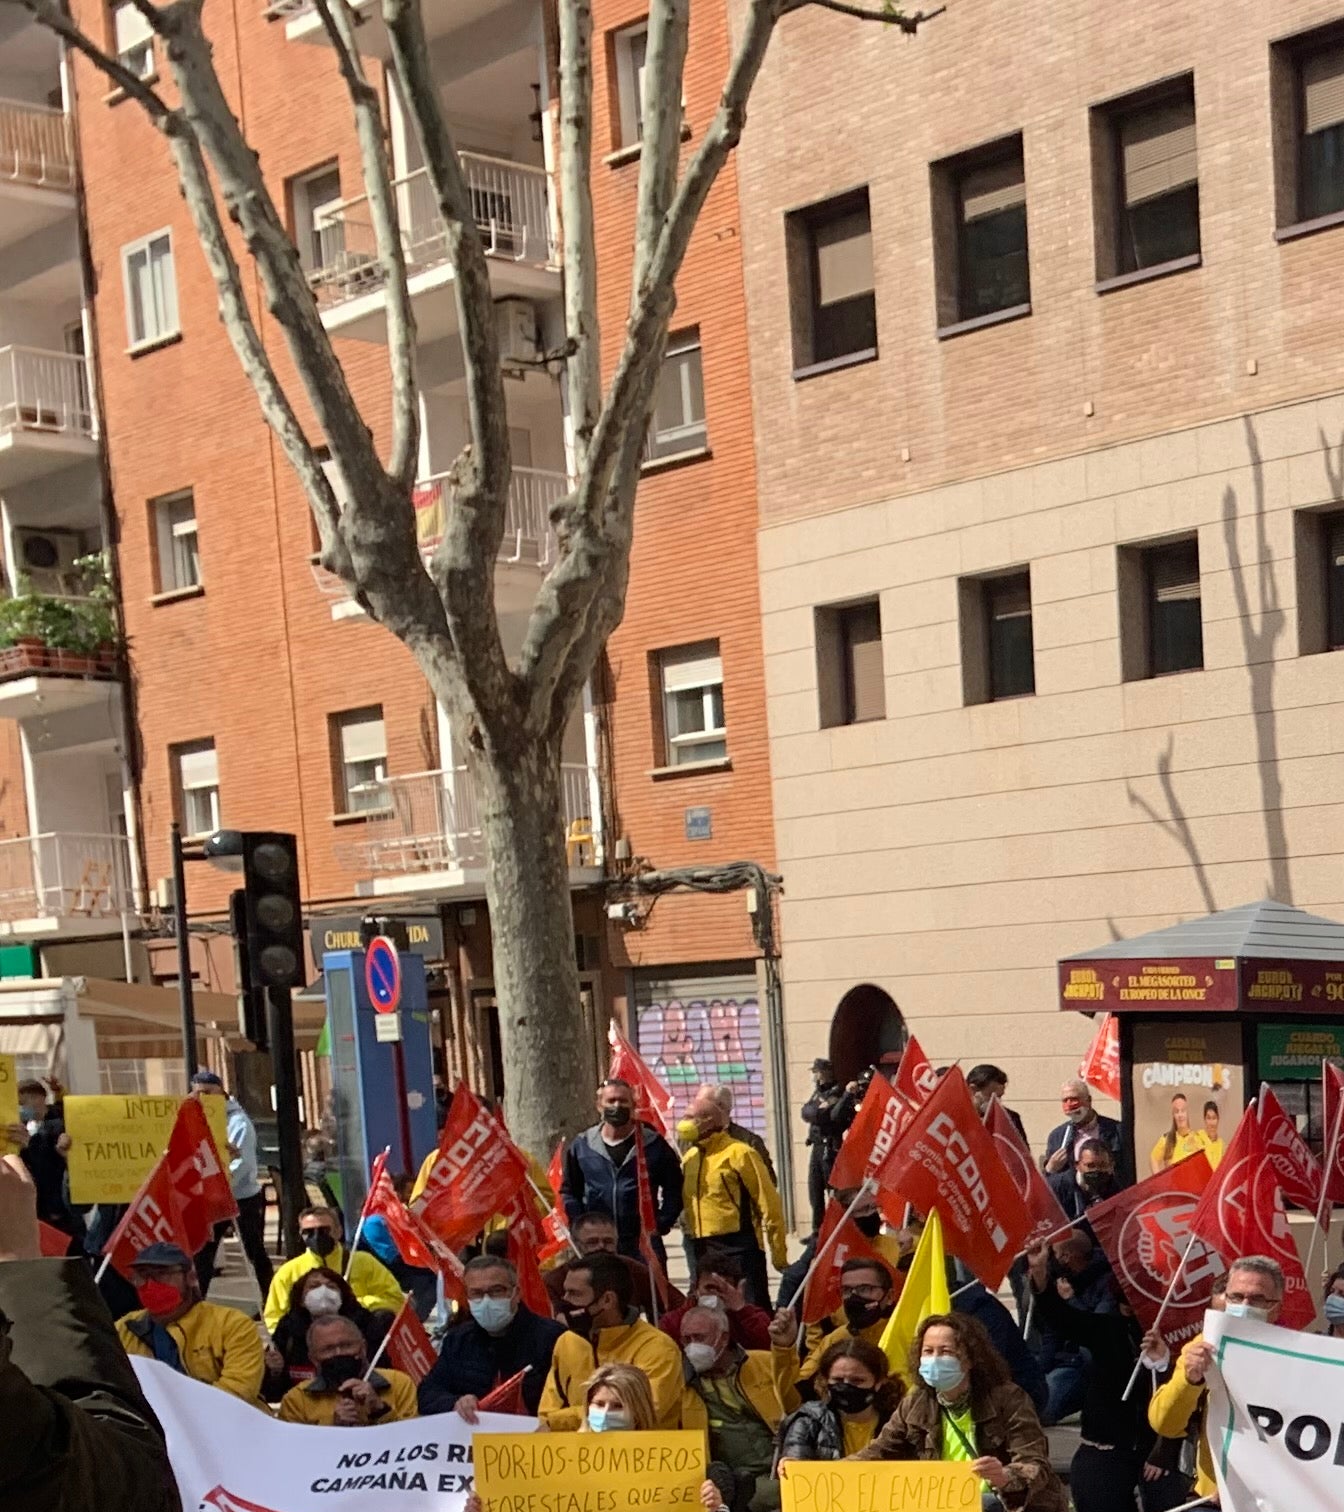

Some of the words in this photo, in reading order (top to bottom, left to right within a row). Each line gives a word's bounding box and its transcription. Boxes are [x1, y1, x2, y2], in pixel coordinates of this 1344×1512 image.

[926, 1112, 990, 1213] CCOO
[337, 1453, 372, 1469] NO
[374, 1449, 389, 1465] A
[396, 1443, 439, 1463] LOS
[310, 1466, 428, 1493] CAMPAÑA
[889, 1474, 977, 1512] EMPLEO
[627, 1487, 664, 1505] QUE
[668, 1486, 695, 1504] SE
